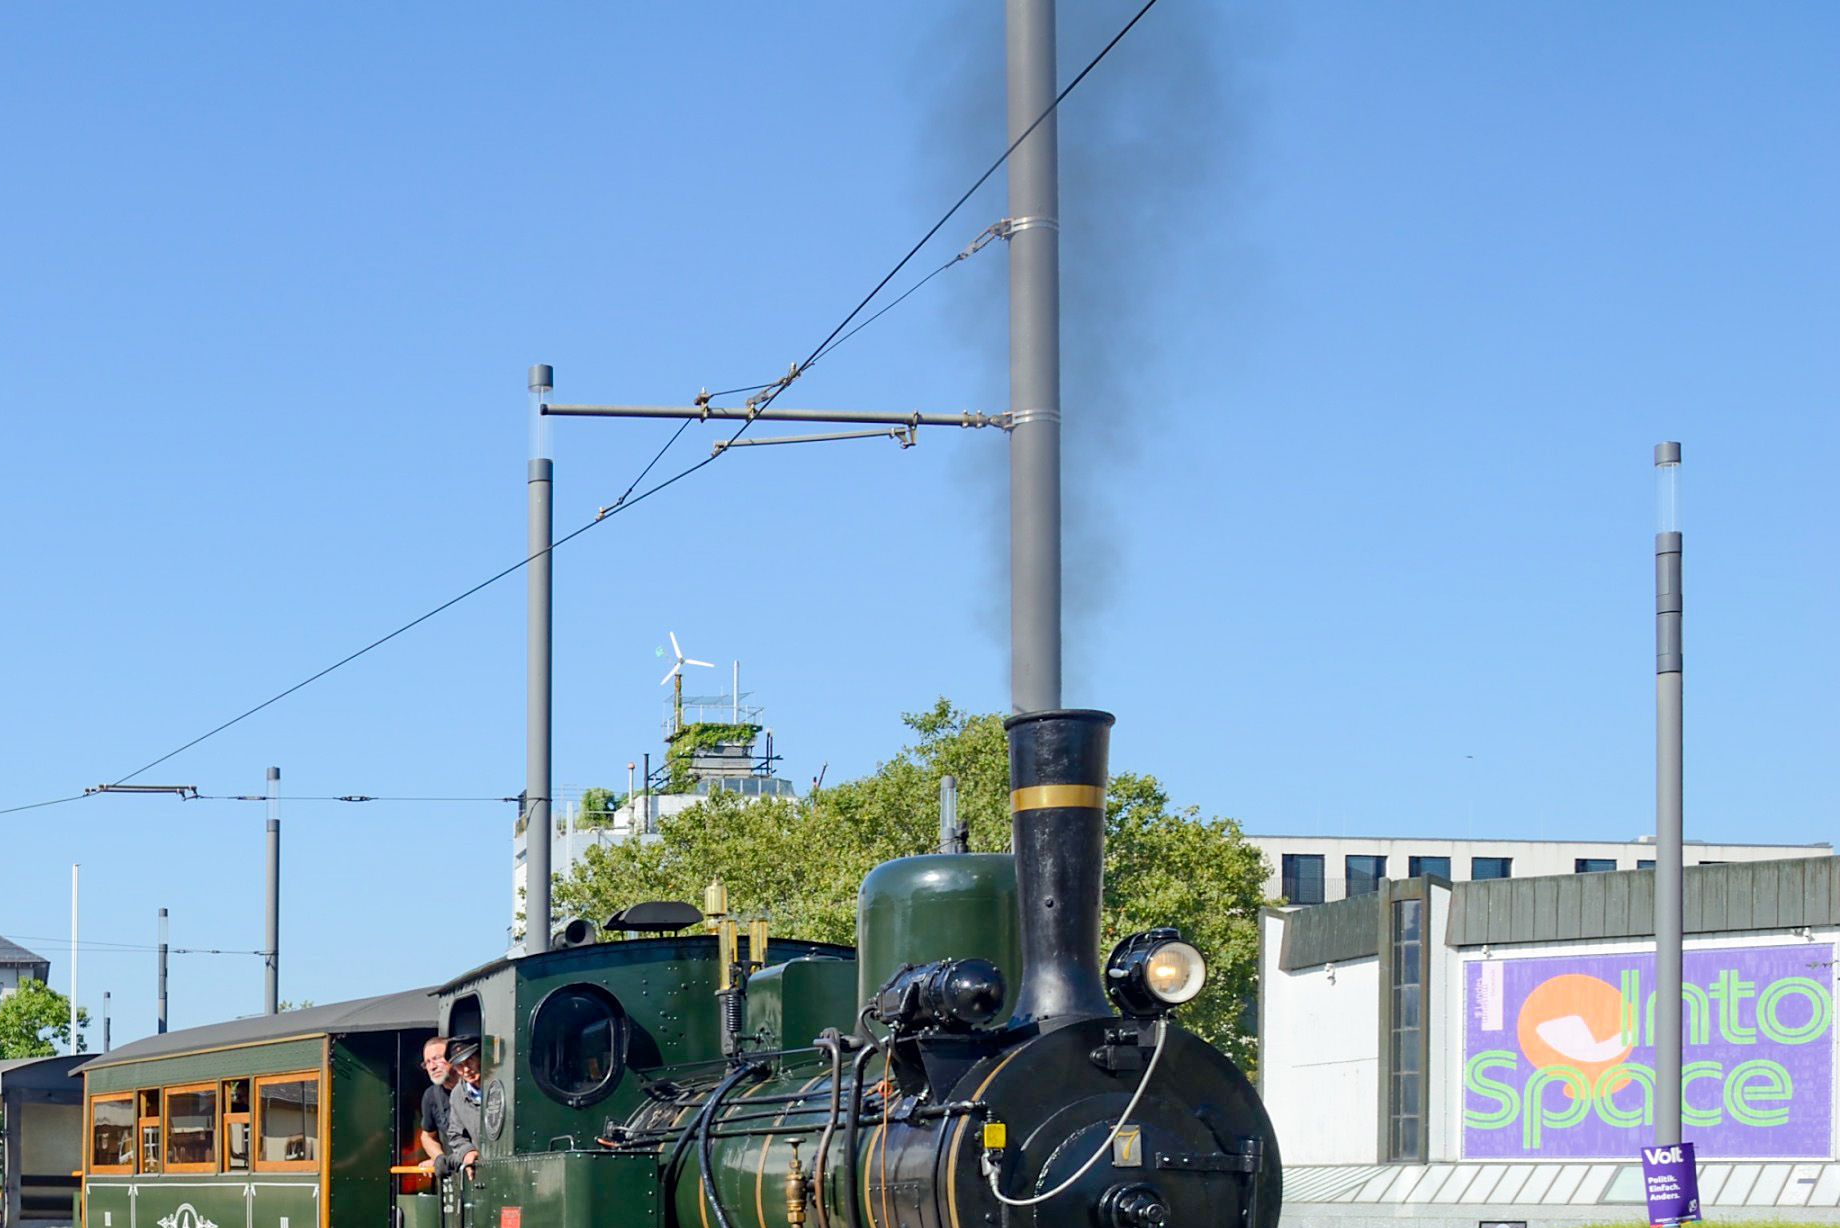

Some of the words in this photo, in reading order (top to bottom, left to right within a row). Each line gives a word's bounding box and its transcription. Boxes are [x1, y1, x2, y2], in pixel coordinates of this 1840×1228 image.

[1621, 969, 1833, 1047] Into
[1464, 1050, 1793, 1149] Space
[1116, 1130, 1139, 1161] 7
[1644, 1146, 1684, 1165] Volt
[1648, 1174, 1677, 1184] Politik.
[1649, 1183, 1680, 1193] Einfach.
[1650, 1192, 1680, 1201] Anders.
